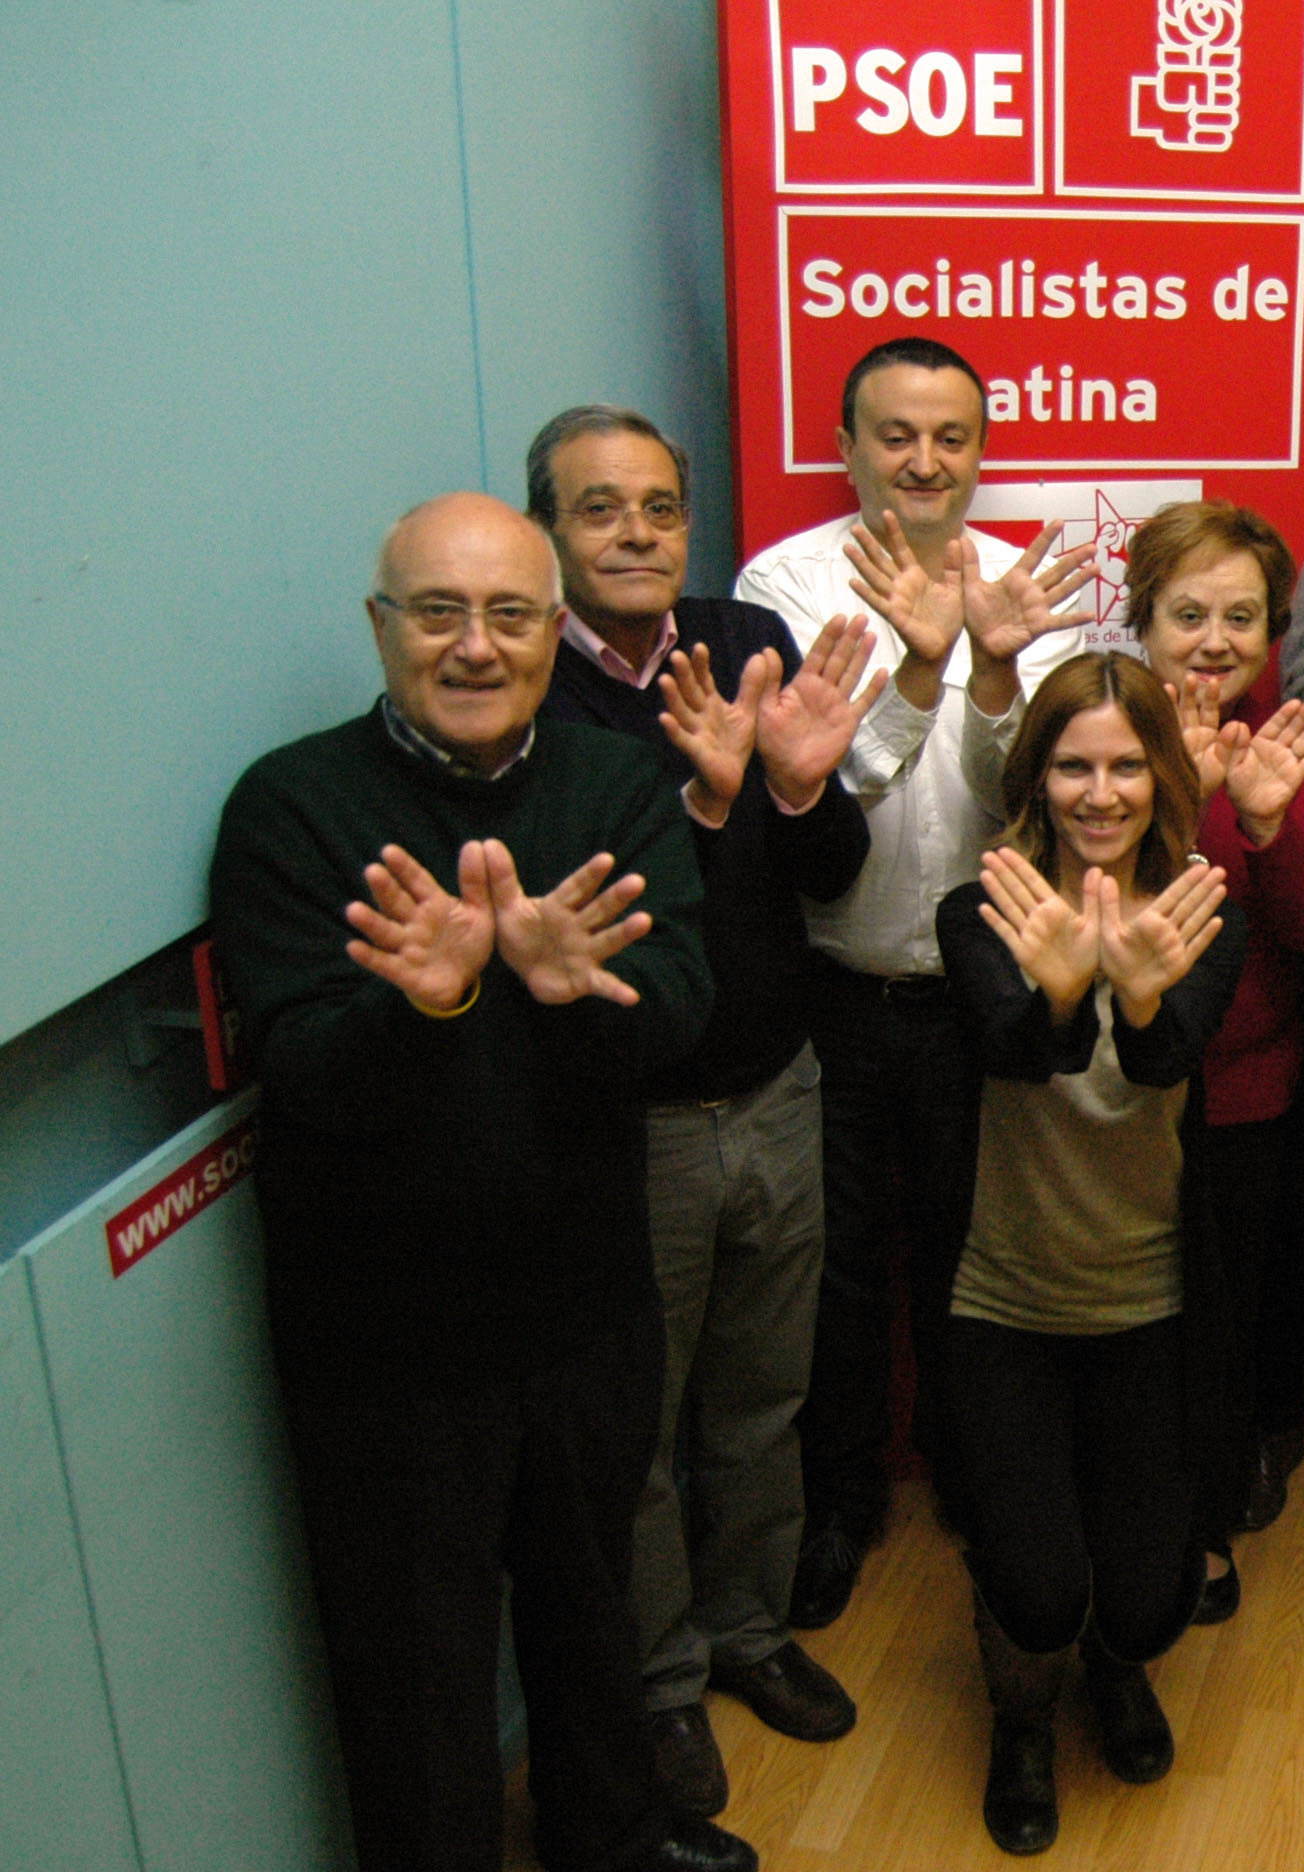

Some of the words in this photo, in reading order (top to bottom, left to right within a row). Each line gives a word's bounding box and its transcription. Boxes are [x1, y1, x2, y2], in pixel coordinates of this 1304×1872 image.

[791, 47, 1023, 137] PSOE
[801, 258, 1188, 321] Socialistas
[1212, 264, 1290, 322] de
[987, 365, 1157, 423] atina
